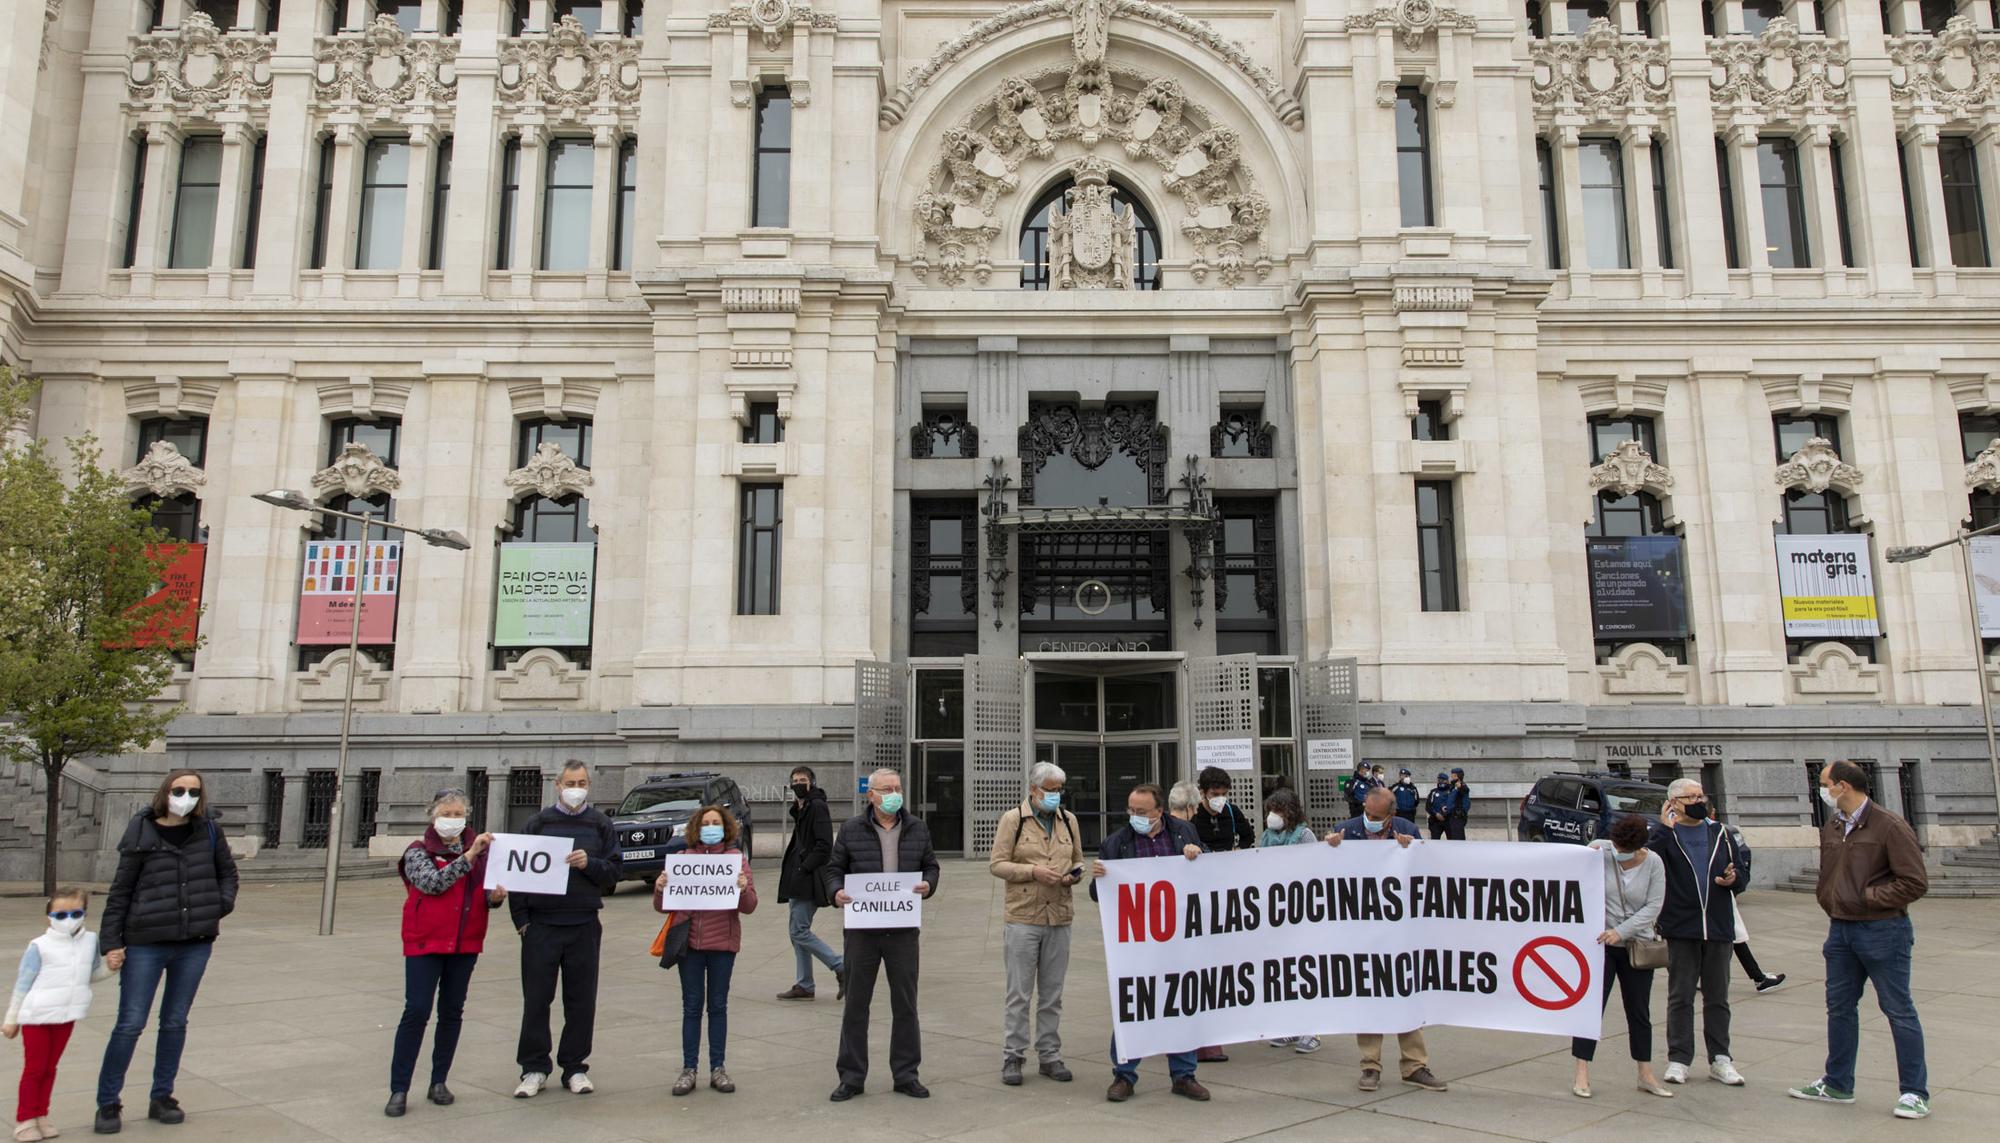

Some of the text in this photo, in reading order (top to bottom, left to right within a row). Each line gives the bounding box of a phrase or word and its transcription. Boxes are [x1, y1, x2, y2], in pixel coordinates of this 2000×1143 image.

[1791, 549, 1856, 563] materia
[1594, 560, 1631, 568] Estamos
[503, 571, 587, 581] PANORAMA
[1595, 572, 1640, 580] Canciones
[1826, 564, 1857, 579] gris
[503, 585, 587, 595] MADRID 01
[1597, 588, 1635, 596] olvidado
[1605, 745, 1722, 757] TAQUILLA TICKETS
[507, 849, 551, 874] NO
[672, 864, 733, 876] COCINAS
[669, 885, 735, 896] FANTASMA
[865, 881, 900, 892] CALLE
[852, 900, 913, 912] CANILLAS
[1117, 875, 1585, 943] NO A LAS COCINAS FANTASMA
[1118, 948, 1498, 1023] EN ZONAS RESIDENCIALES
